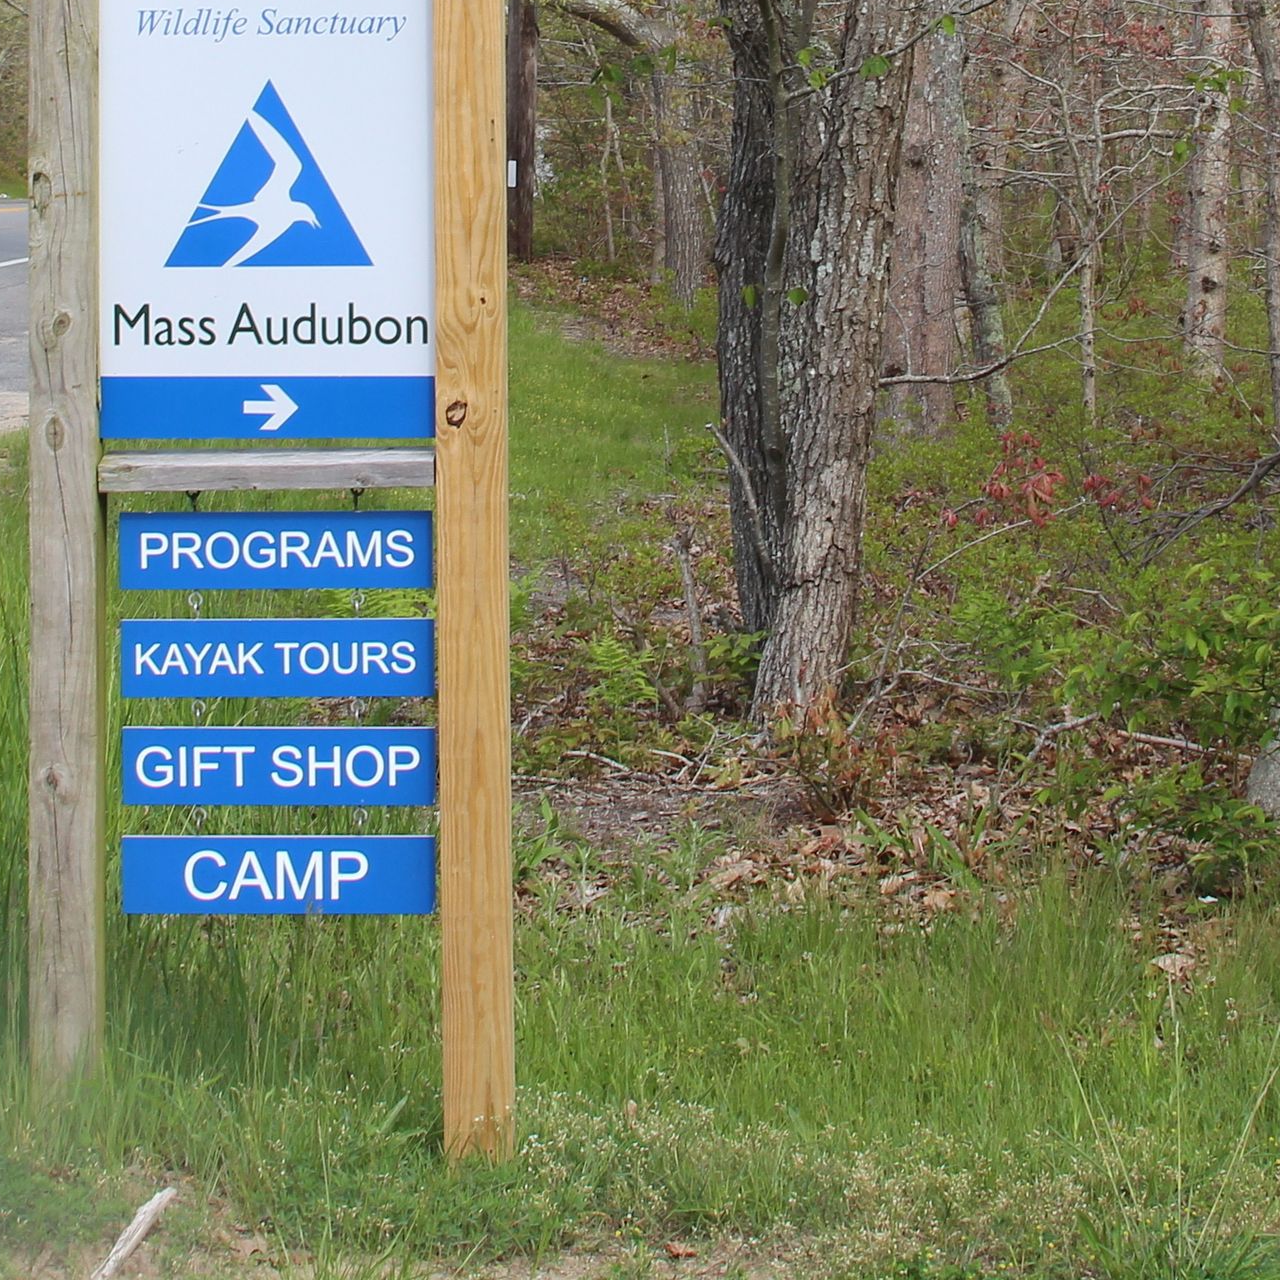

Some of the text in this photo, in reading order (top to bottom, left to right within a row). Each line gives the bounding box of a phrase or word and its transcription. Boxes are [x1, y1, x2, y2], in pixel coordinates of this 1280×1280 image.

[136, 7, 407, 43] Wildlife Sanctuary
[113, 301, 429, 346] Mass Audubon
[139, 529, 416, 570] PROGRAMS
[134, 641, 417, 675] KAYAK TOURS
[135, 745, 421, 788] GIFT SHOP
[183, 850, 369, 901] CAMP
